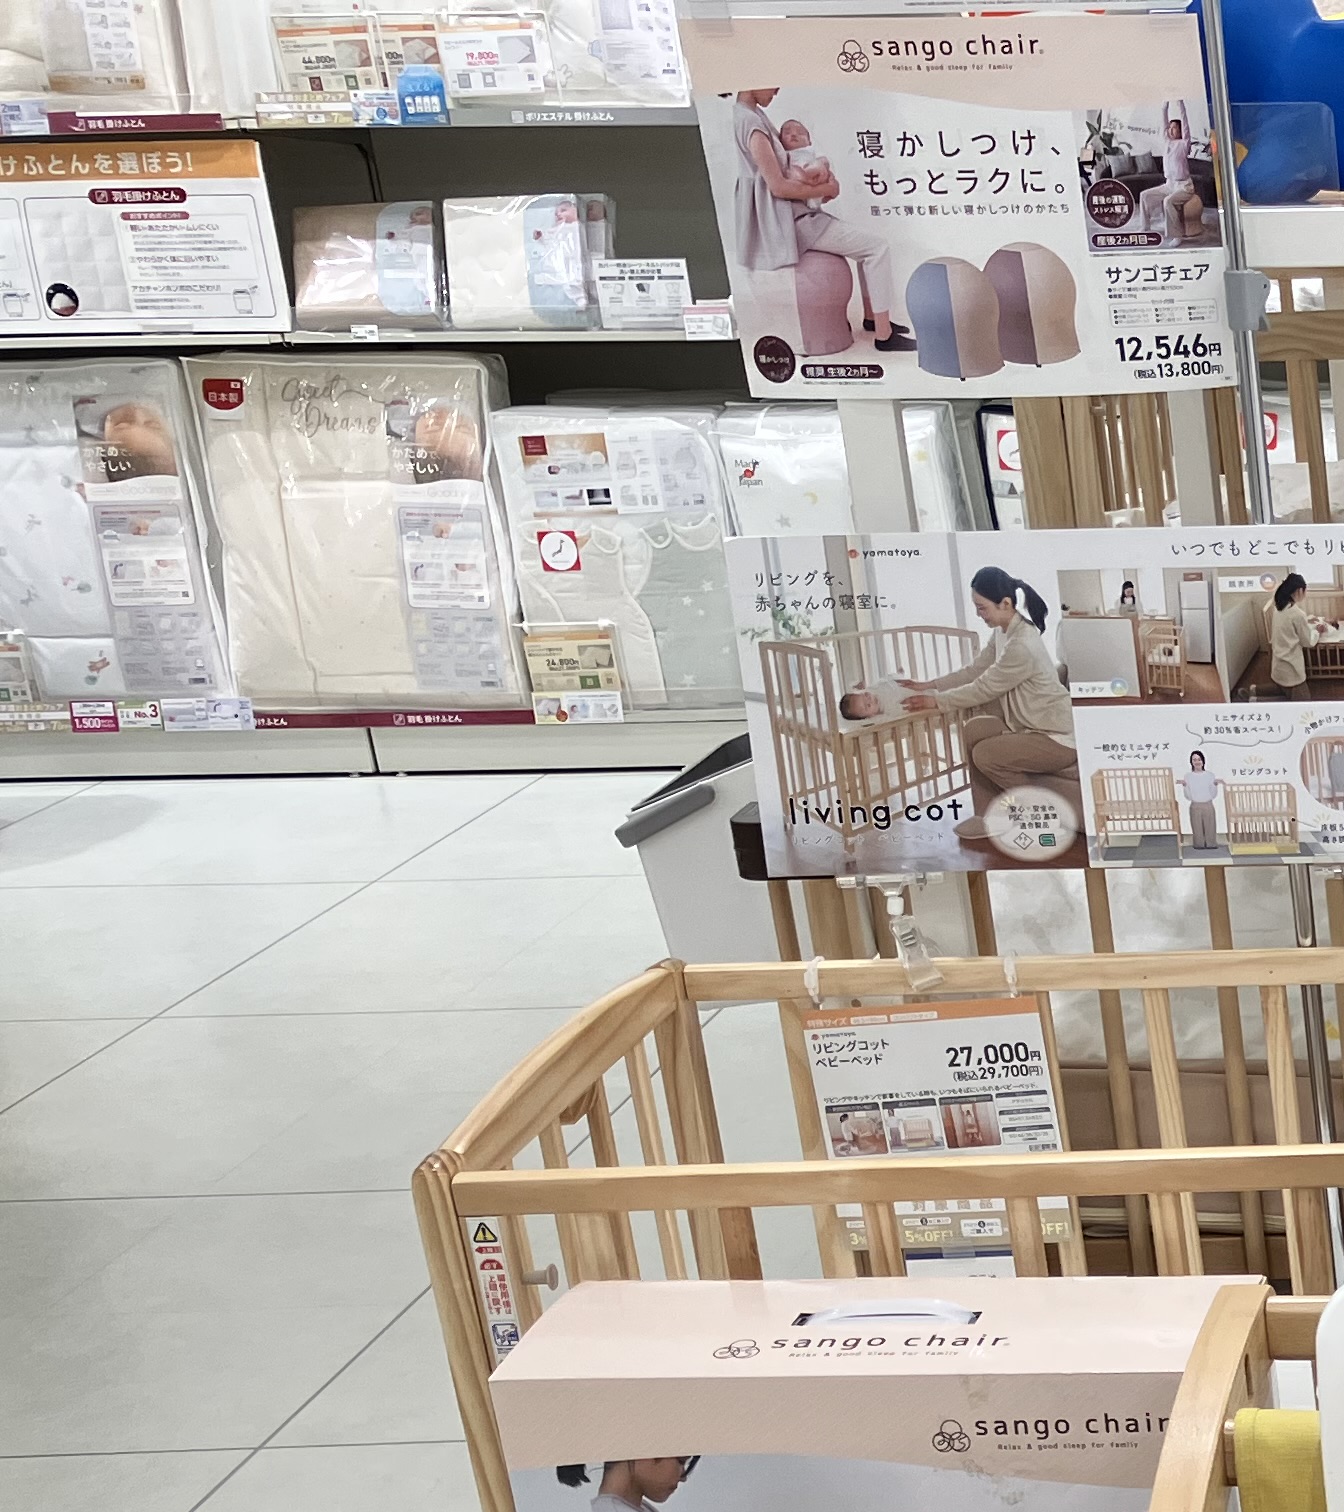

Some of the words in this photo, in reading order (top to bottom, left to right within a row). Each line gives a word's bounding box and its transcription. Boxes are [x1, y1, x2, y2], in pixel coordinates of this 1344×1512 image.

[872, 38, 953, 61] sango
[965, 34, 1039, 57] chair
[856, 129, 1063, 160] 寝かしつけ、
[862, 166, 1068, 197] もっとラクに。
[1105, 263, 1210, 285] サンゴチェア
[1115, 333, 1222, 362] 12,546円
[1133, 360, 1224, 380] (税込13,800円)
[208, 392, 238, 404] 日本製
[753, 570, 845, 588] リビングを、
[754, 592, 898, 613] 赤ちゃんの寝室に。
[1213, 712, 1272, 723] ミニサイズより
[1094, 742, 1171, 753] 一般的なミニサイズ
[1107, 751, 1158, 762] ベビーベッド
[1230, 767, 1289, 778] リビングコット
[789, 798, 892, 830] living
[904, 799, 964, 822] cot
[1019, 821, 1050, 830] 適合製品
[811, 1038, 890, 1055] リビングコット
[945, 1041, 1042, 1068] 27,000円
[815, 1053, 884, 1068] ベビーベッド
[952, 1063, 1044, 1082] (税込29,700円)
[771, 1335, 888, 1352] sango
[905, 1332, 1006, 1348] chair
[974, 1416, 1072, 1440] sango
[1084, 1411, 1170, 1435] chair
[1037, 1442, 1060, 1452] good
[1110, 1441, 1140, 1451] family
